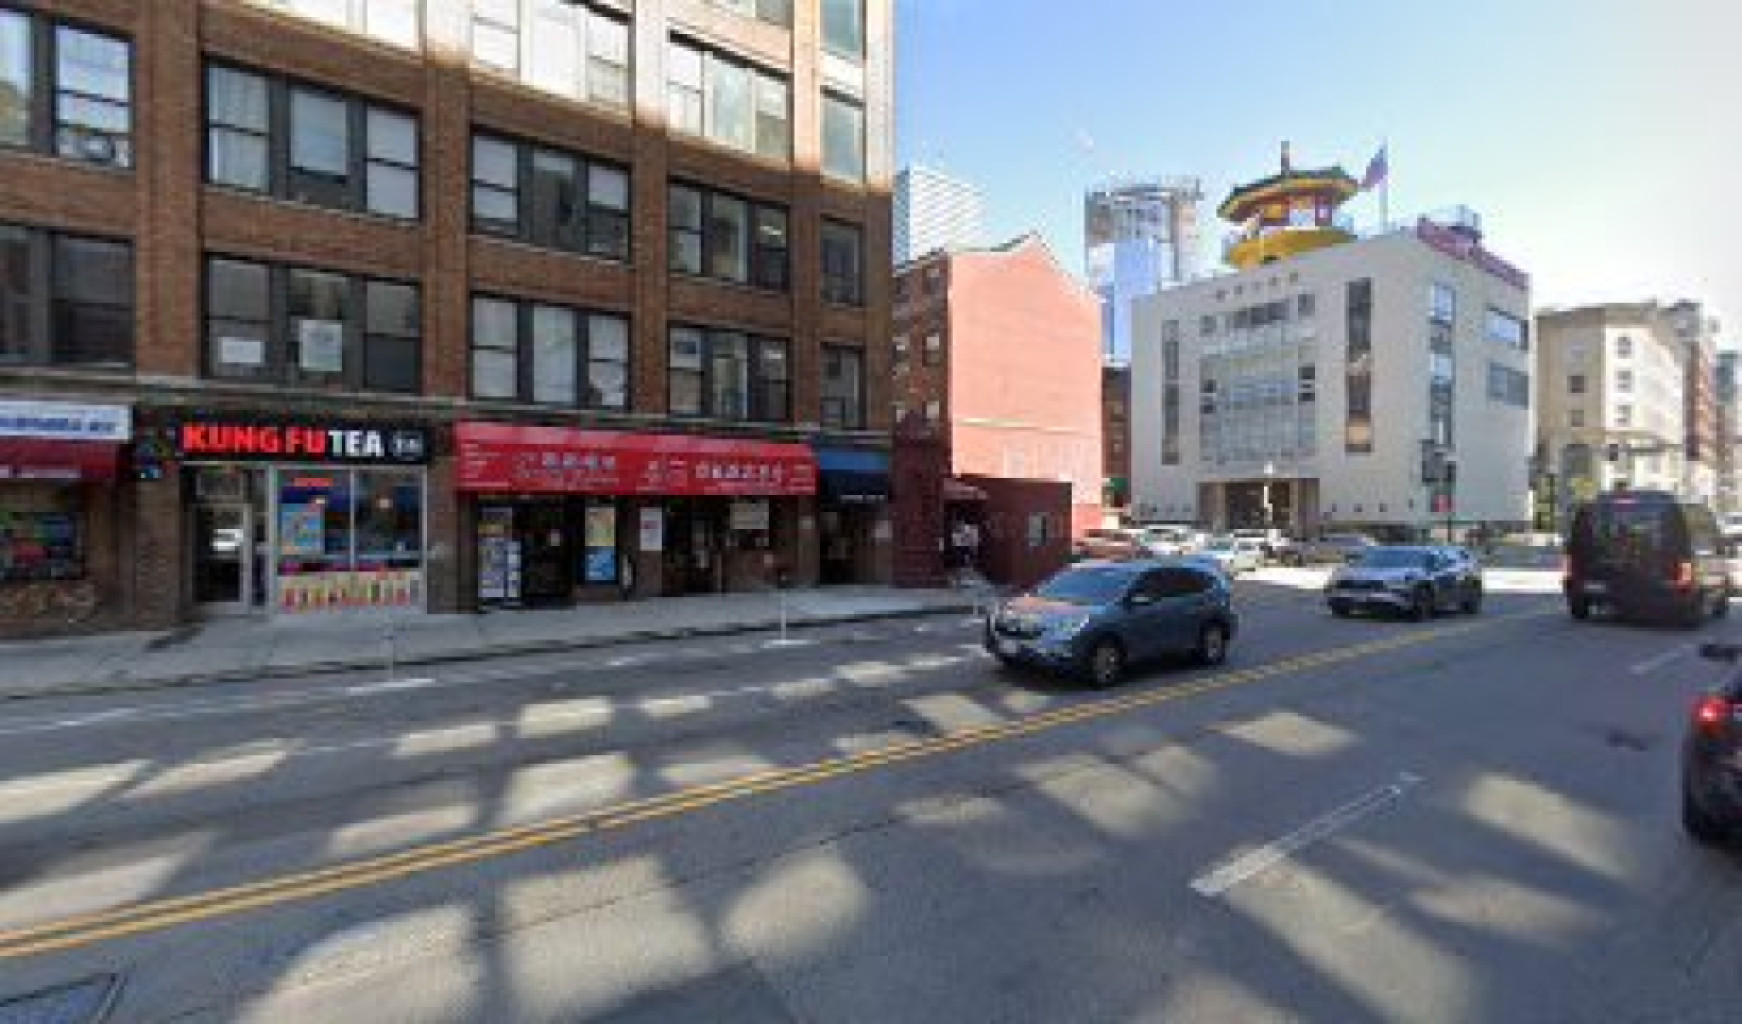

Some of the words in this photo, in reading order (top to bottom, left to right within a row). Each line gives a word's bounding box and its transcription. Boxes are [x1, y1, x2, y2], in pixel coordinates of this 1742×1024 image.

[182, 424, 280, 453] KUNG
[285, 426, 326, 454] FU
[328, 430, 385, 456] TEA
